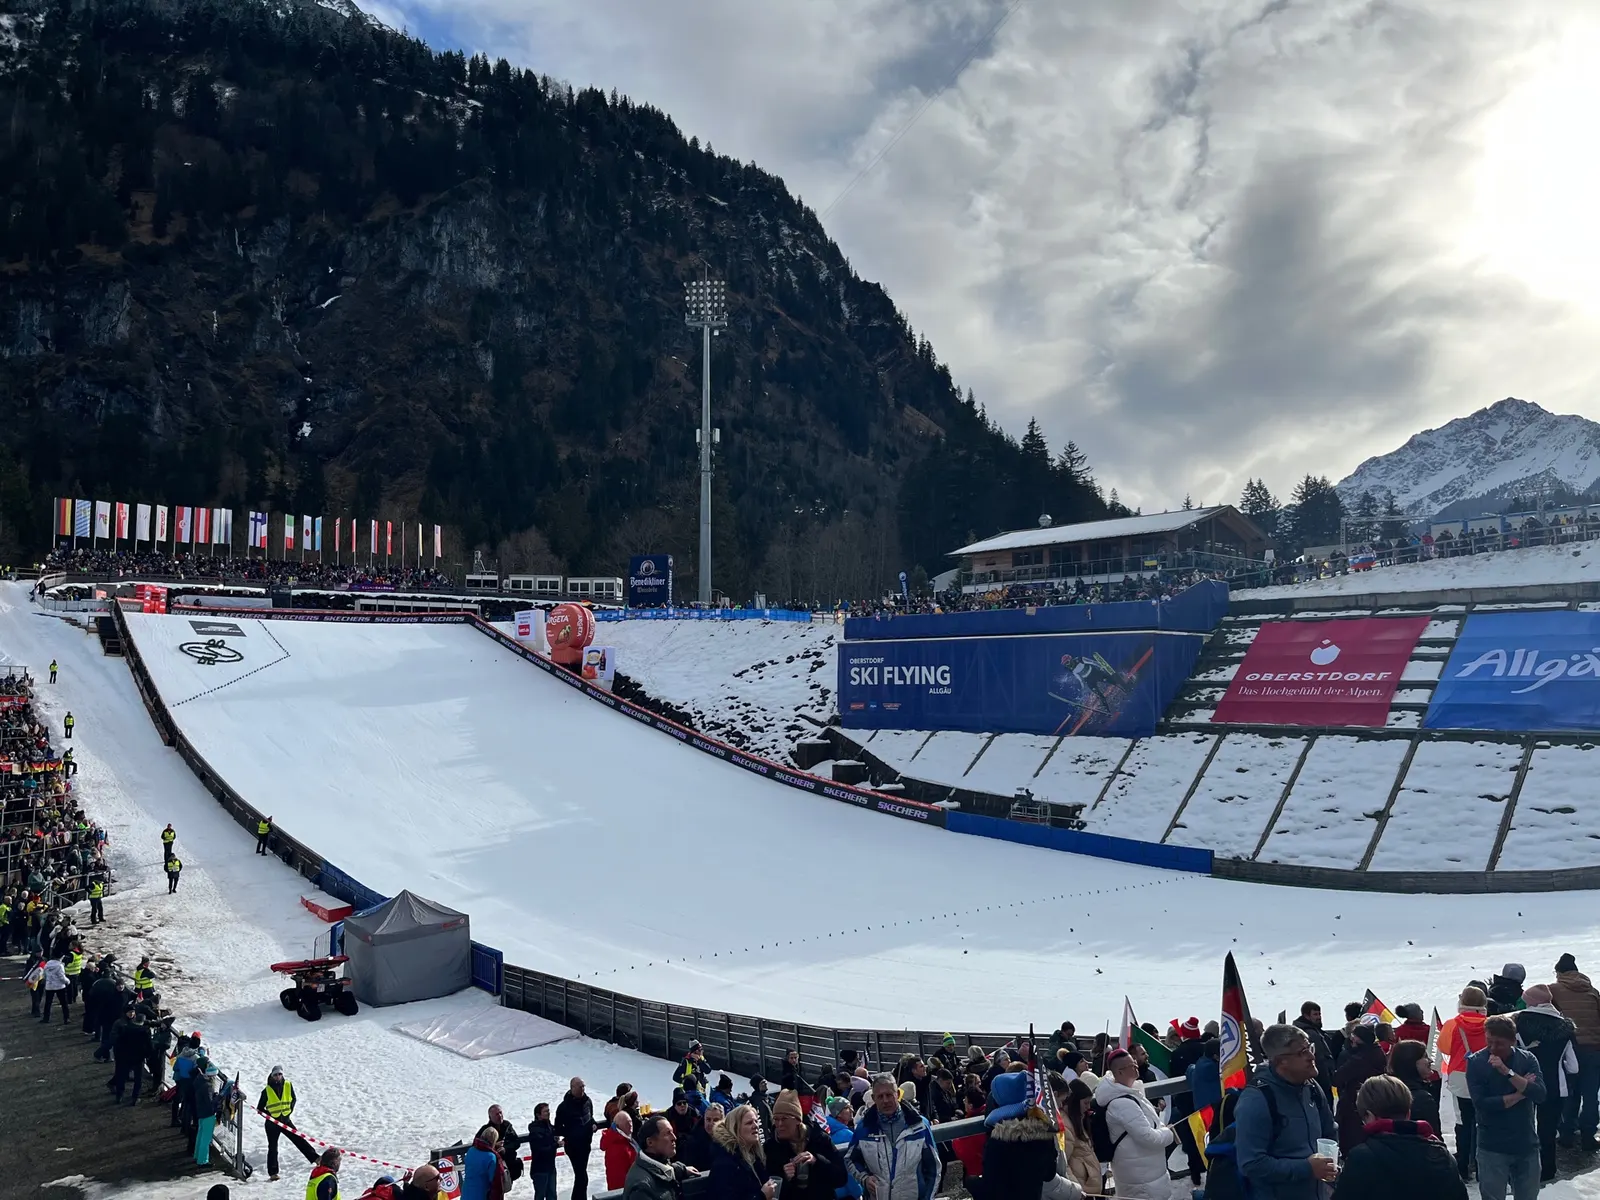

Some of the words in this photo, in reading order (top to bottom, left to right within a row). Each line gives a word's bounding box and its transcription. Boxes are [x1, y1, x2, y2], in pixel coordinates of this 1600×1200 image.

[630, 577, 665, 587] Benediktiner
[526, 653, 551, 671] SKECHERS
[555, 669, 582, 688] SKECHERS
[850, 667, 878, 685] SKI
[883, 665, 951, 685] FLYING
[1245, 672, 1392, 681] OBERSTDORF
[586, 687, 615, 706] SKECHERS
[1238, 686, 1258, 695] Das
[1261, 686, 1322, 697] Hochgefühl
[1324, 687, 1344, 696] der
[1346, 687, 1383, 698] Alpen.
[620, 704, 651, 723] SKECHERS
[656, 721, 687, 740] SKECHERS
[692, 737, 726, 757] SKECHERS
[731, 754, 768, 774] SKECHERS
[774, 771, 816, 790] SKECHERS
[823, 786, 868, 805] SKECHERS
[877, 801, 929, 820] SKECHERS
